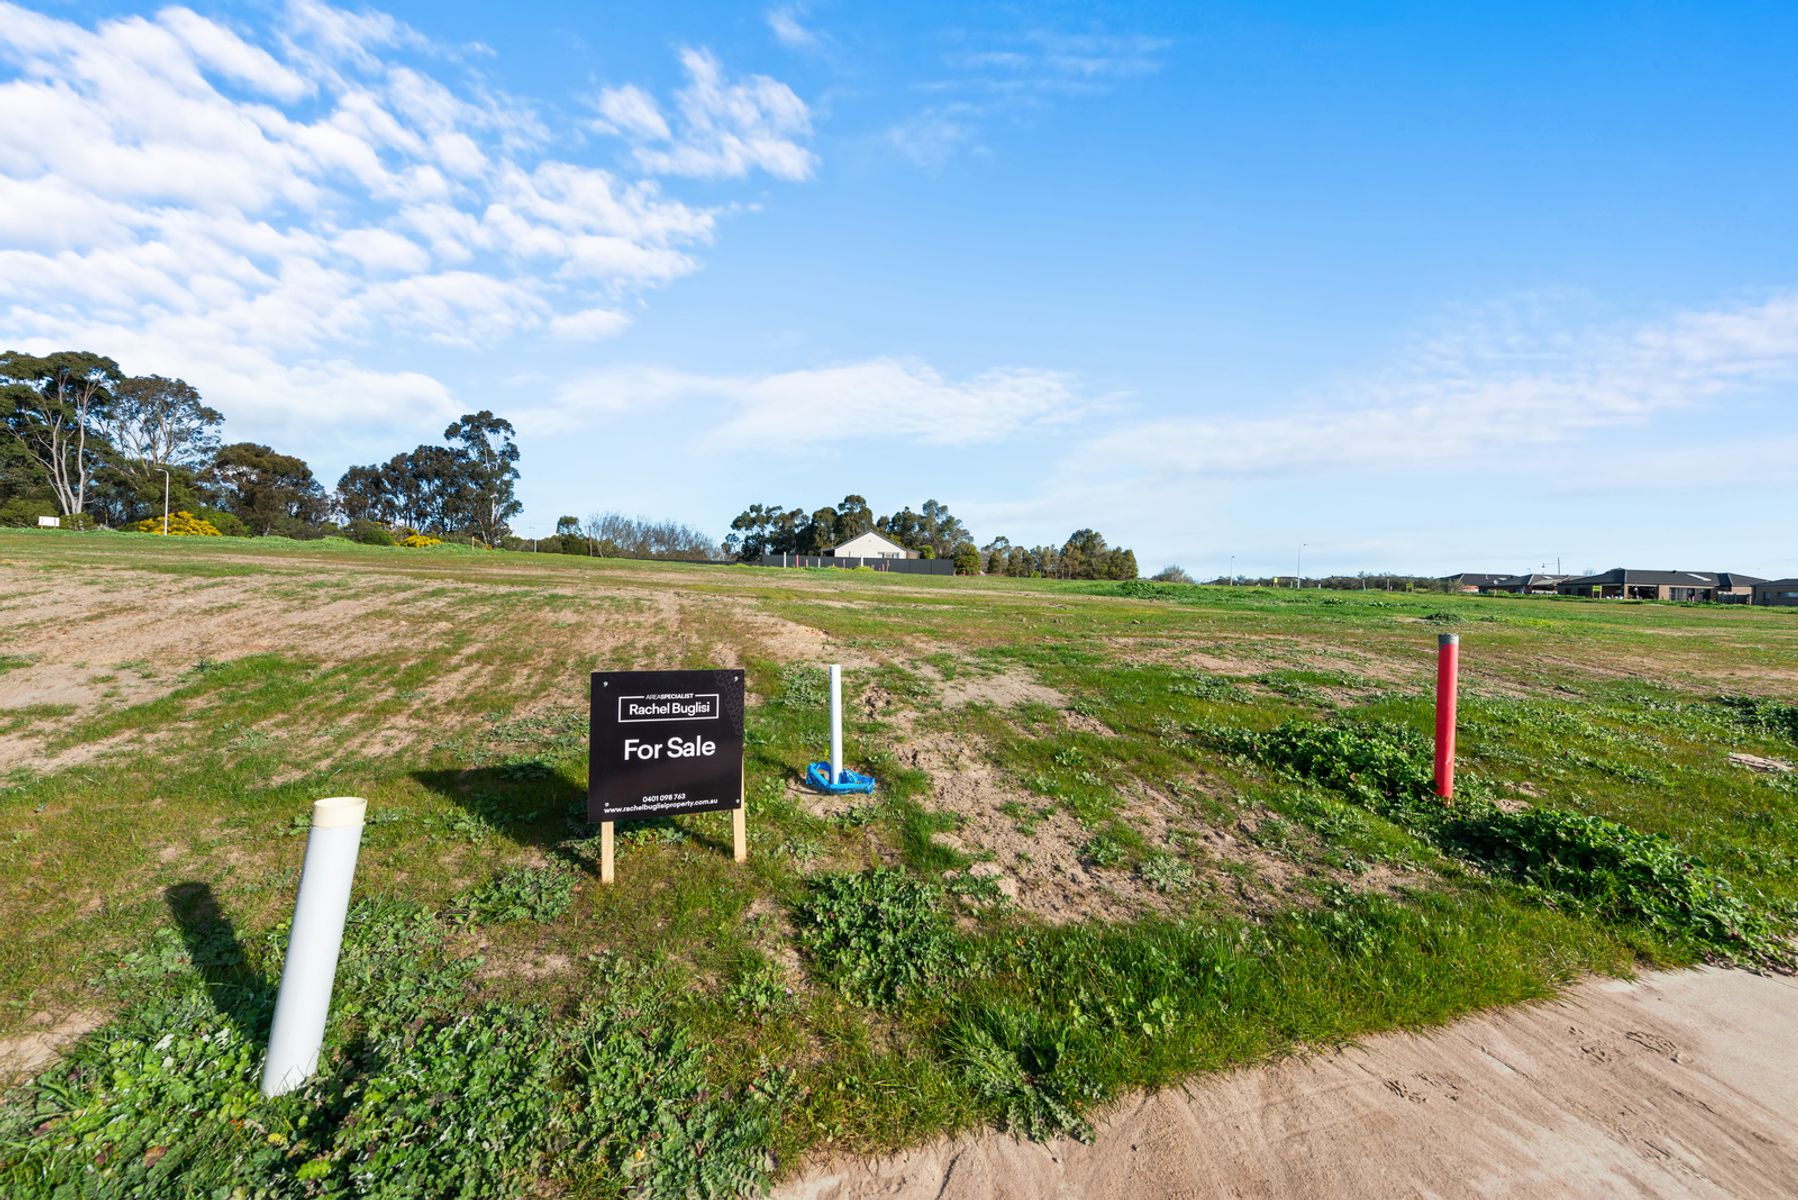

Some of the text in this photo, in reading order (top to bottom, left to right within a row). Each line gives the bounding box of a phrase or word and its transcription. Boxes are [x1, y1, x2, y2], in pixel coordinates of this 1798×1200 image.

[629, 701, 710, 716] Rachel Buglisi
[624, 735, 716, 761] For Sale
[603, 798, 718, 813] www.rachelbuglisiproperty.com.au
